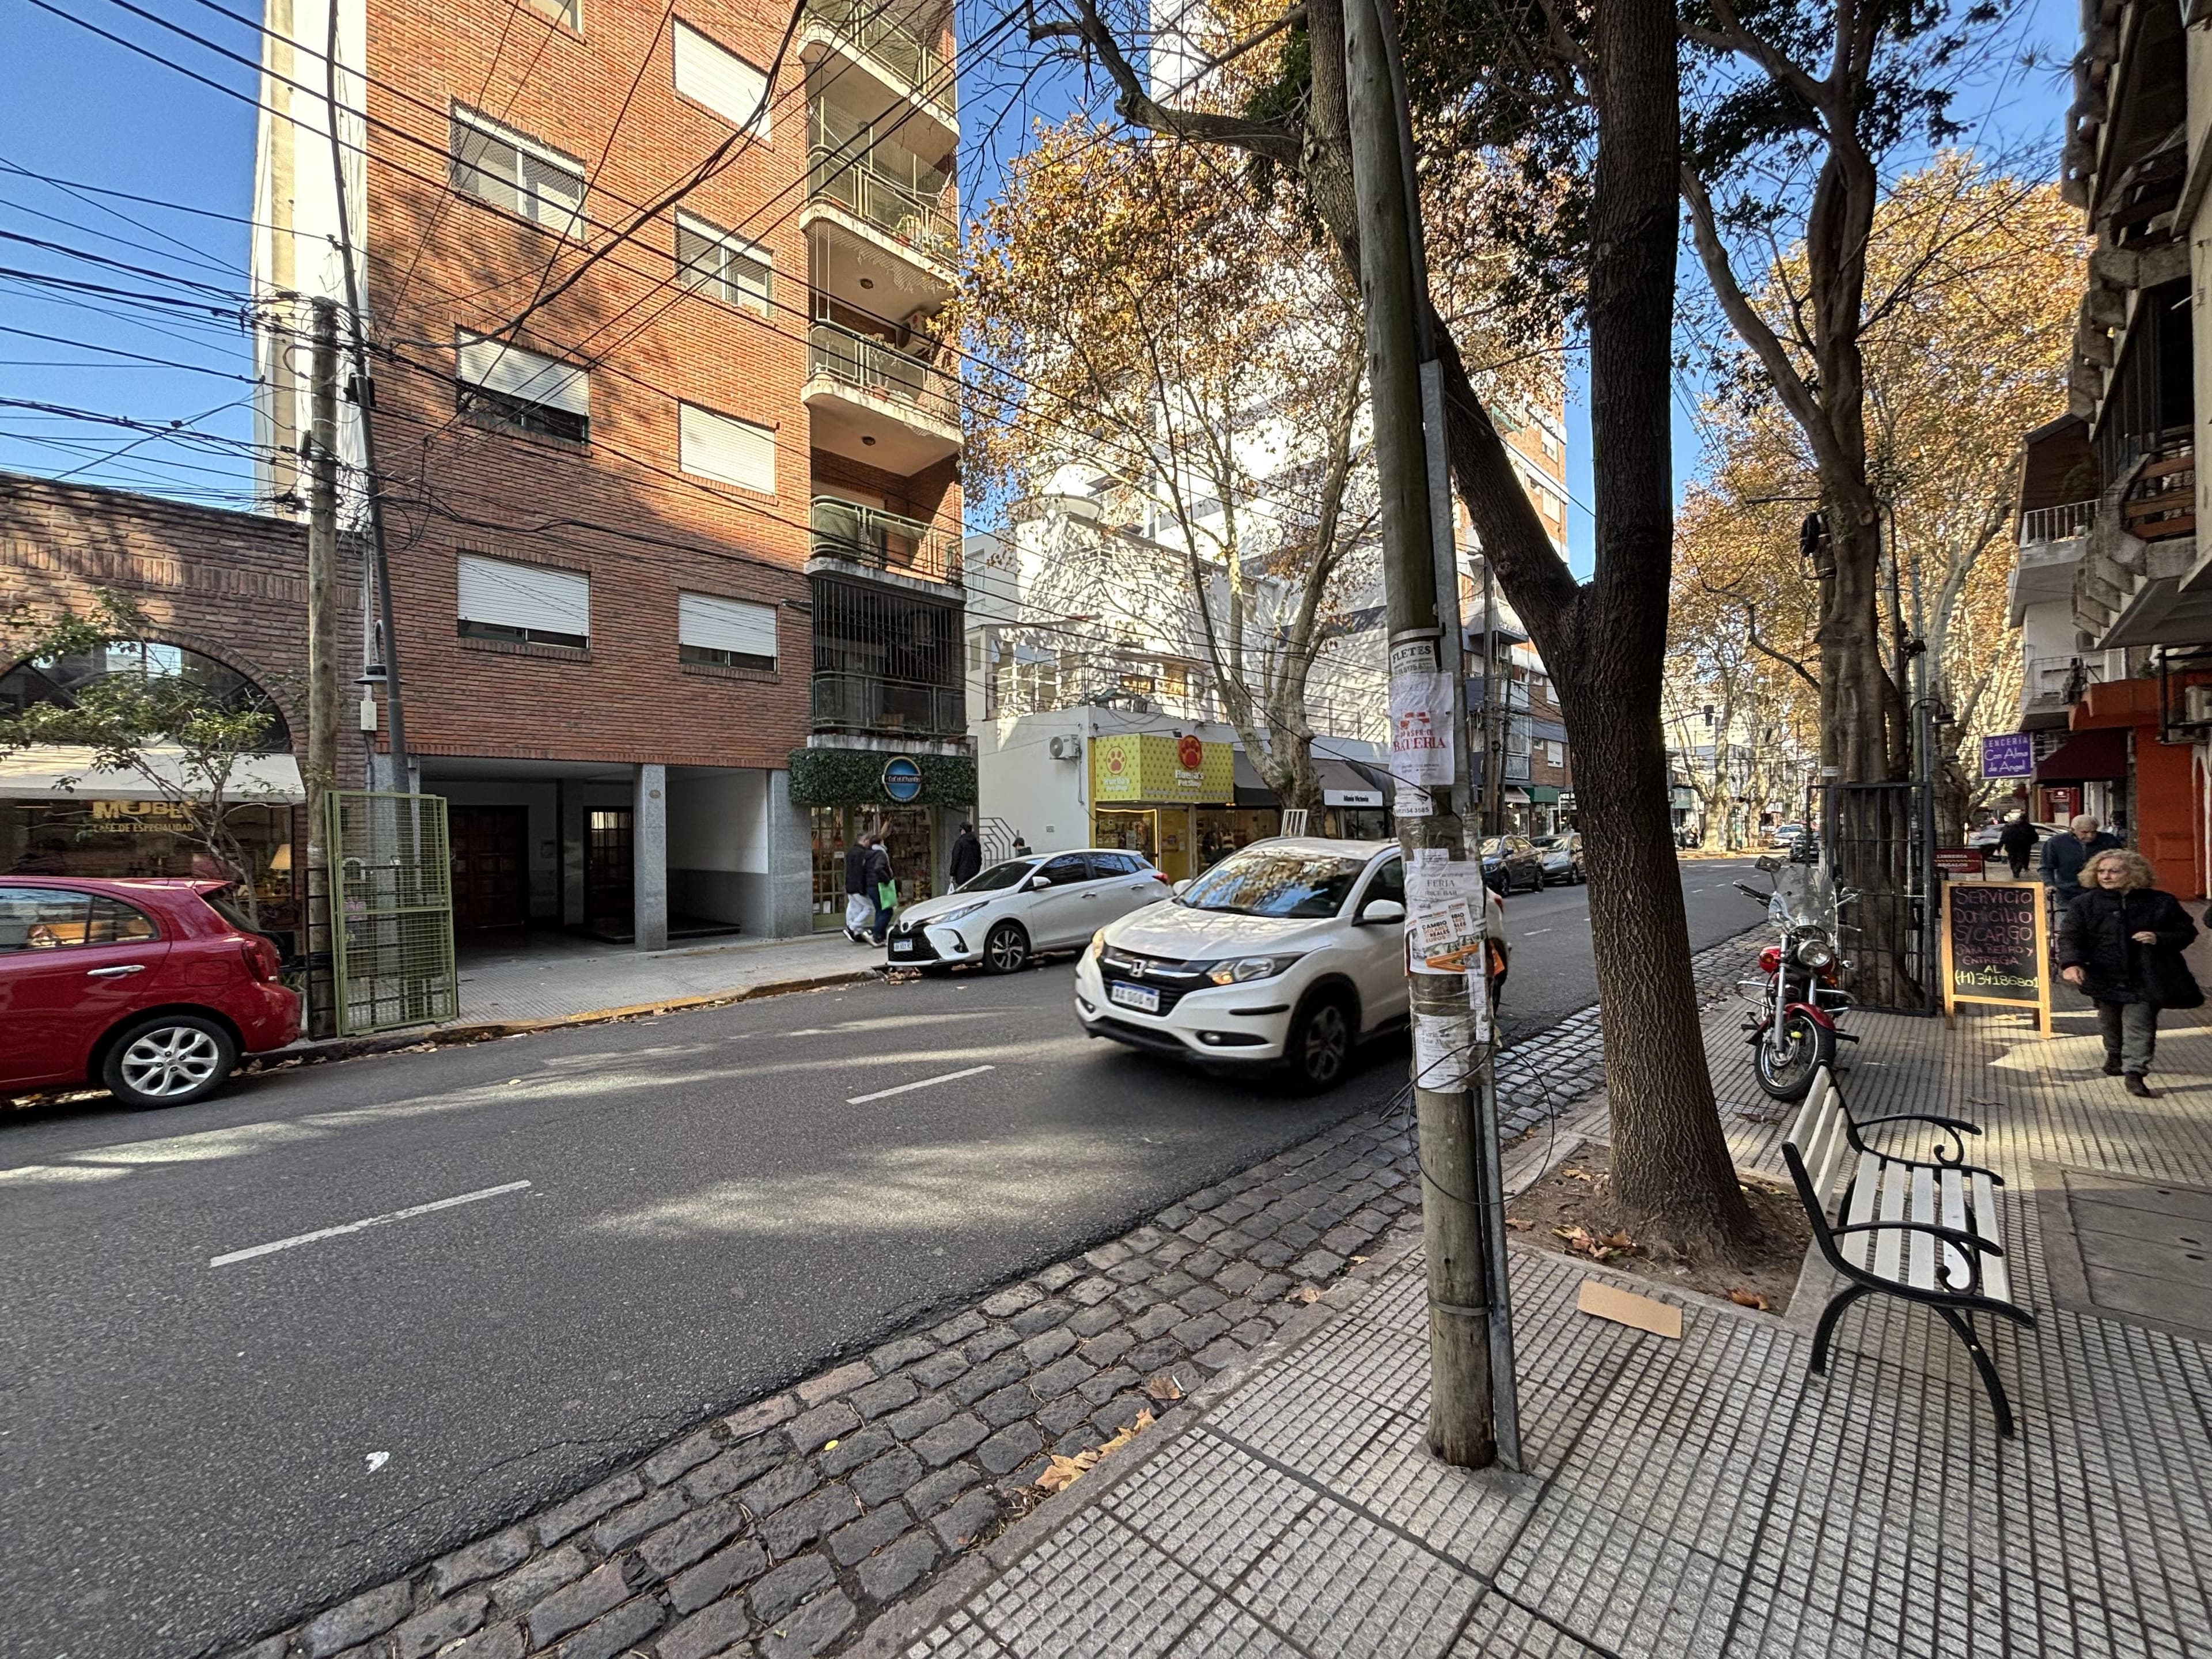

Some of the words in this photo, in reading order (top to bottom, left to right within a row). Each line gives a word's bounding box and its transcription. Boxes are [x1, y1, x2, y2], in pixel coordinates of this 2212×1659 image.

[1392, 646, 1431, 664] FLETES
[1393, 737, 1446, 752] BATERIA
[1988, 762, 1997, 772] de
[1422, 921, 1448, 930] CAMBIO
[1429, 929, 1450, 937] REALES
[1984, 965, 2002, 974] AL
